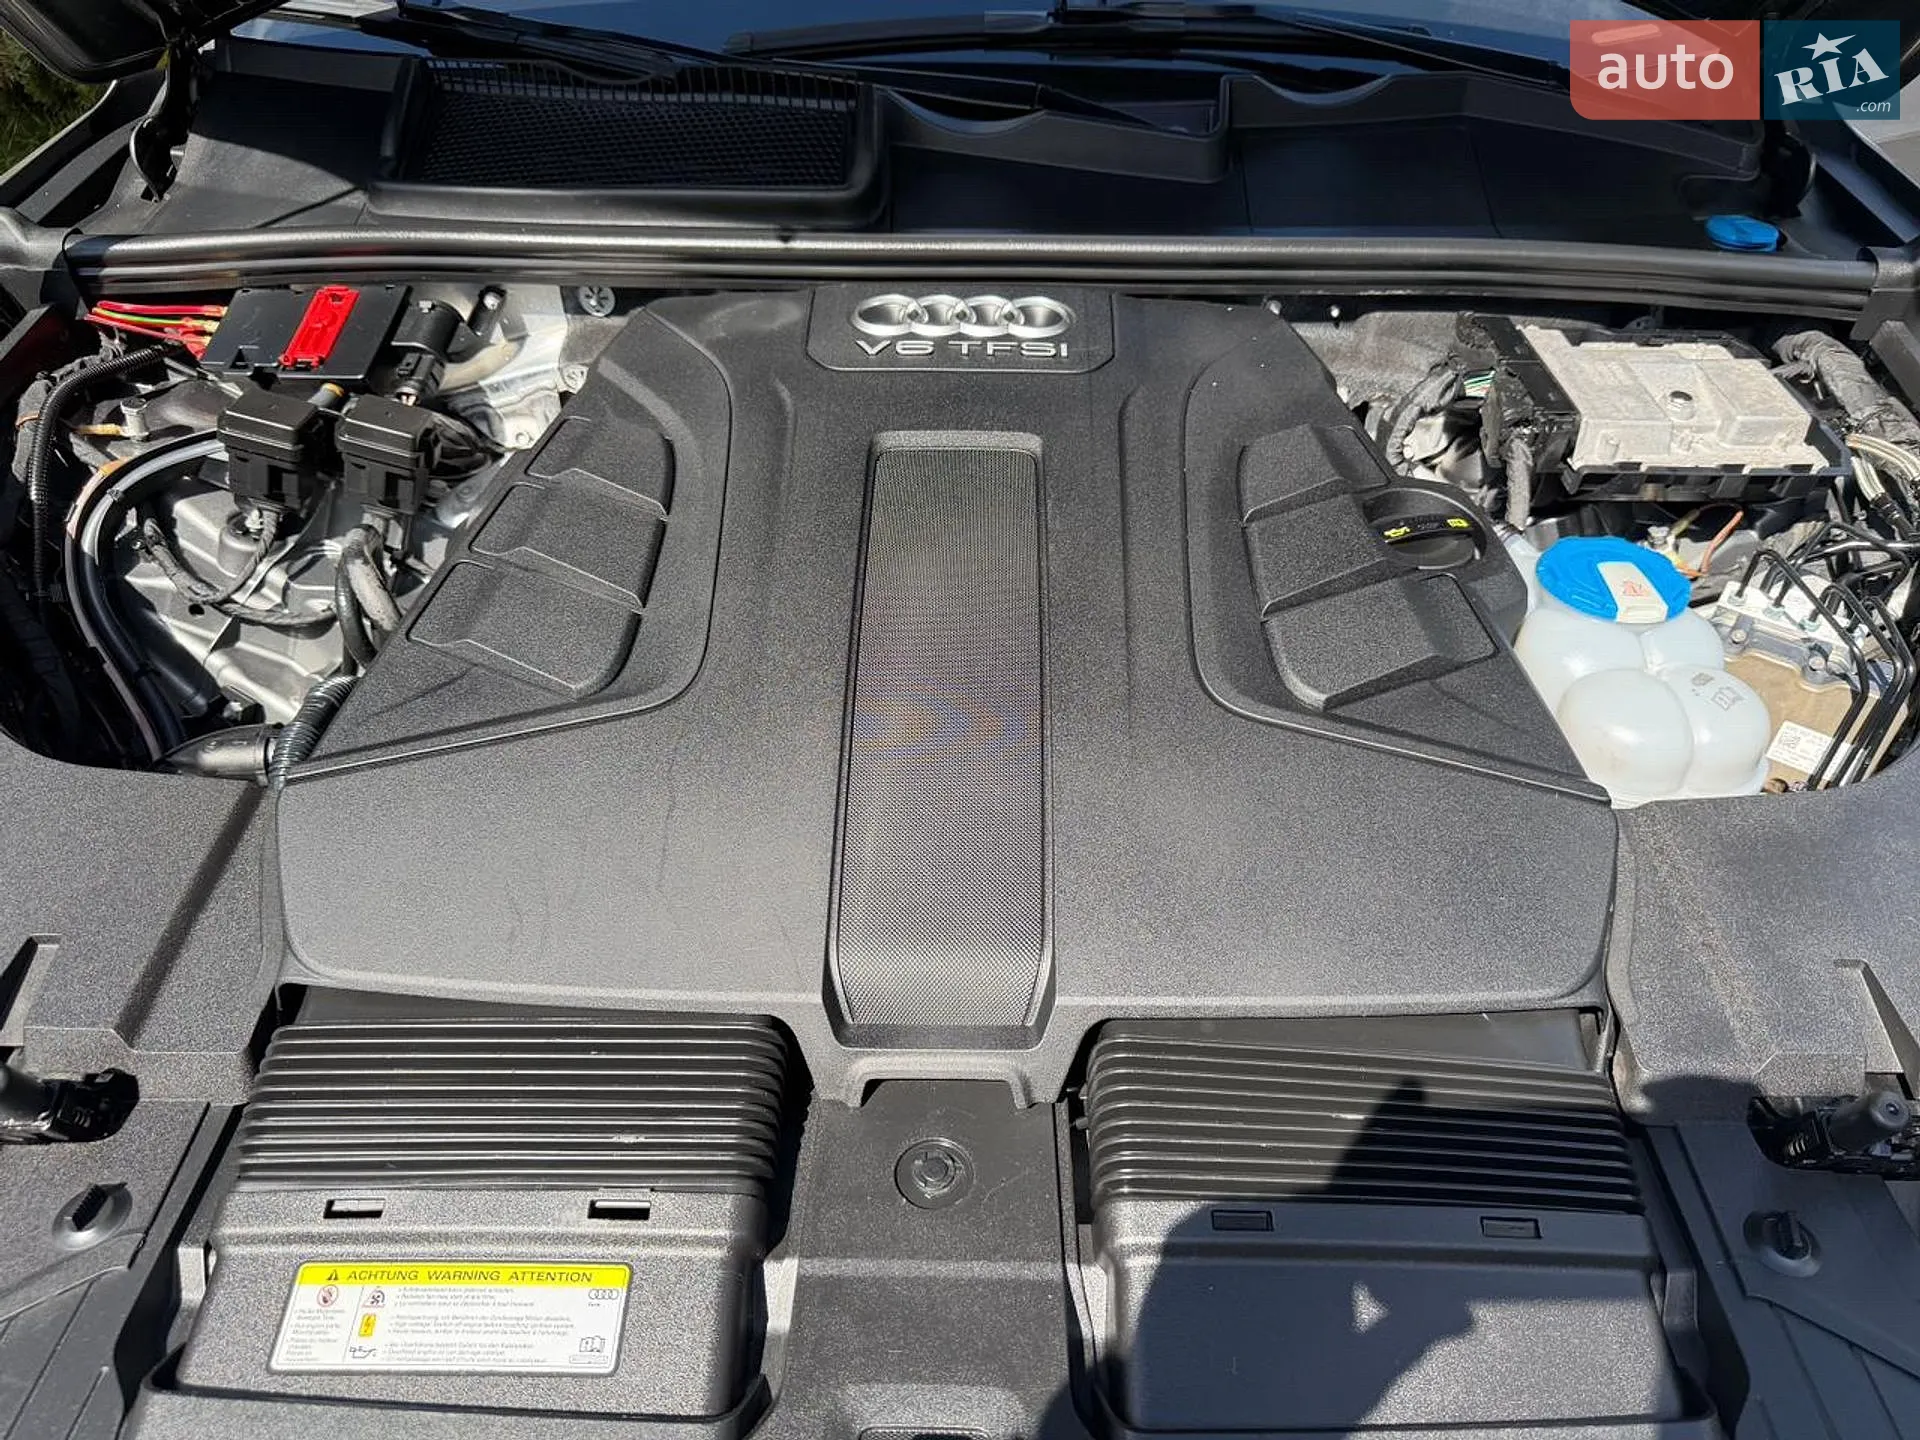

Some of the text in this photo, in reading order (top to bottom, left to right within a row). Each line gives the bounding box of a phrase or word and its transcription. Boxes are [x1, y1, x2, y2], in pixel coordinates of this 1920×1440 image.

[856, 340, 1069, 358] V6 TFSI
[348, 1269, 593, 1284] ACHTUNG WARNING ATTENTION
